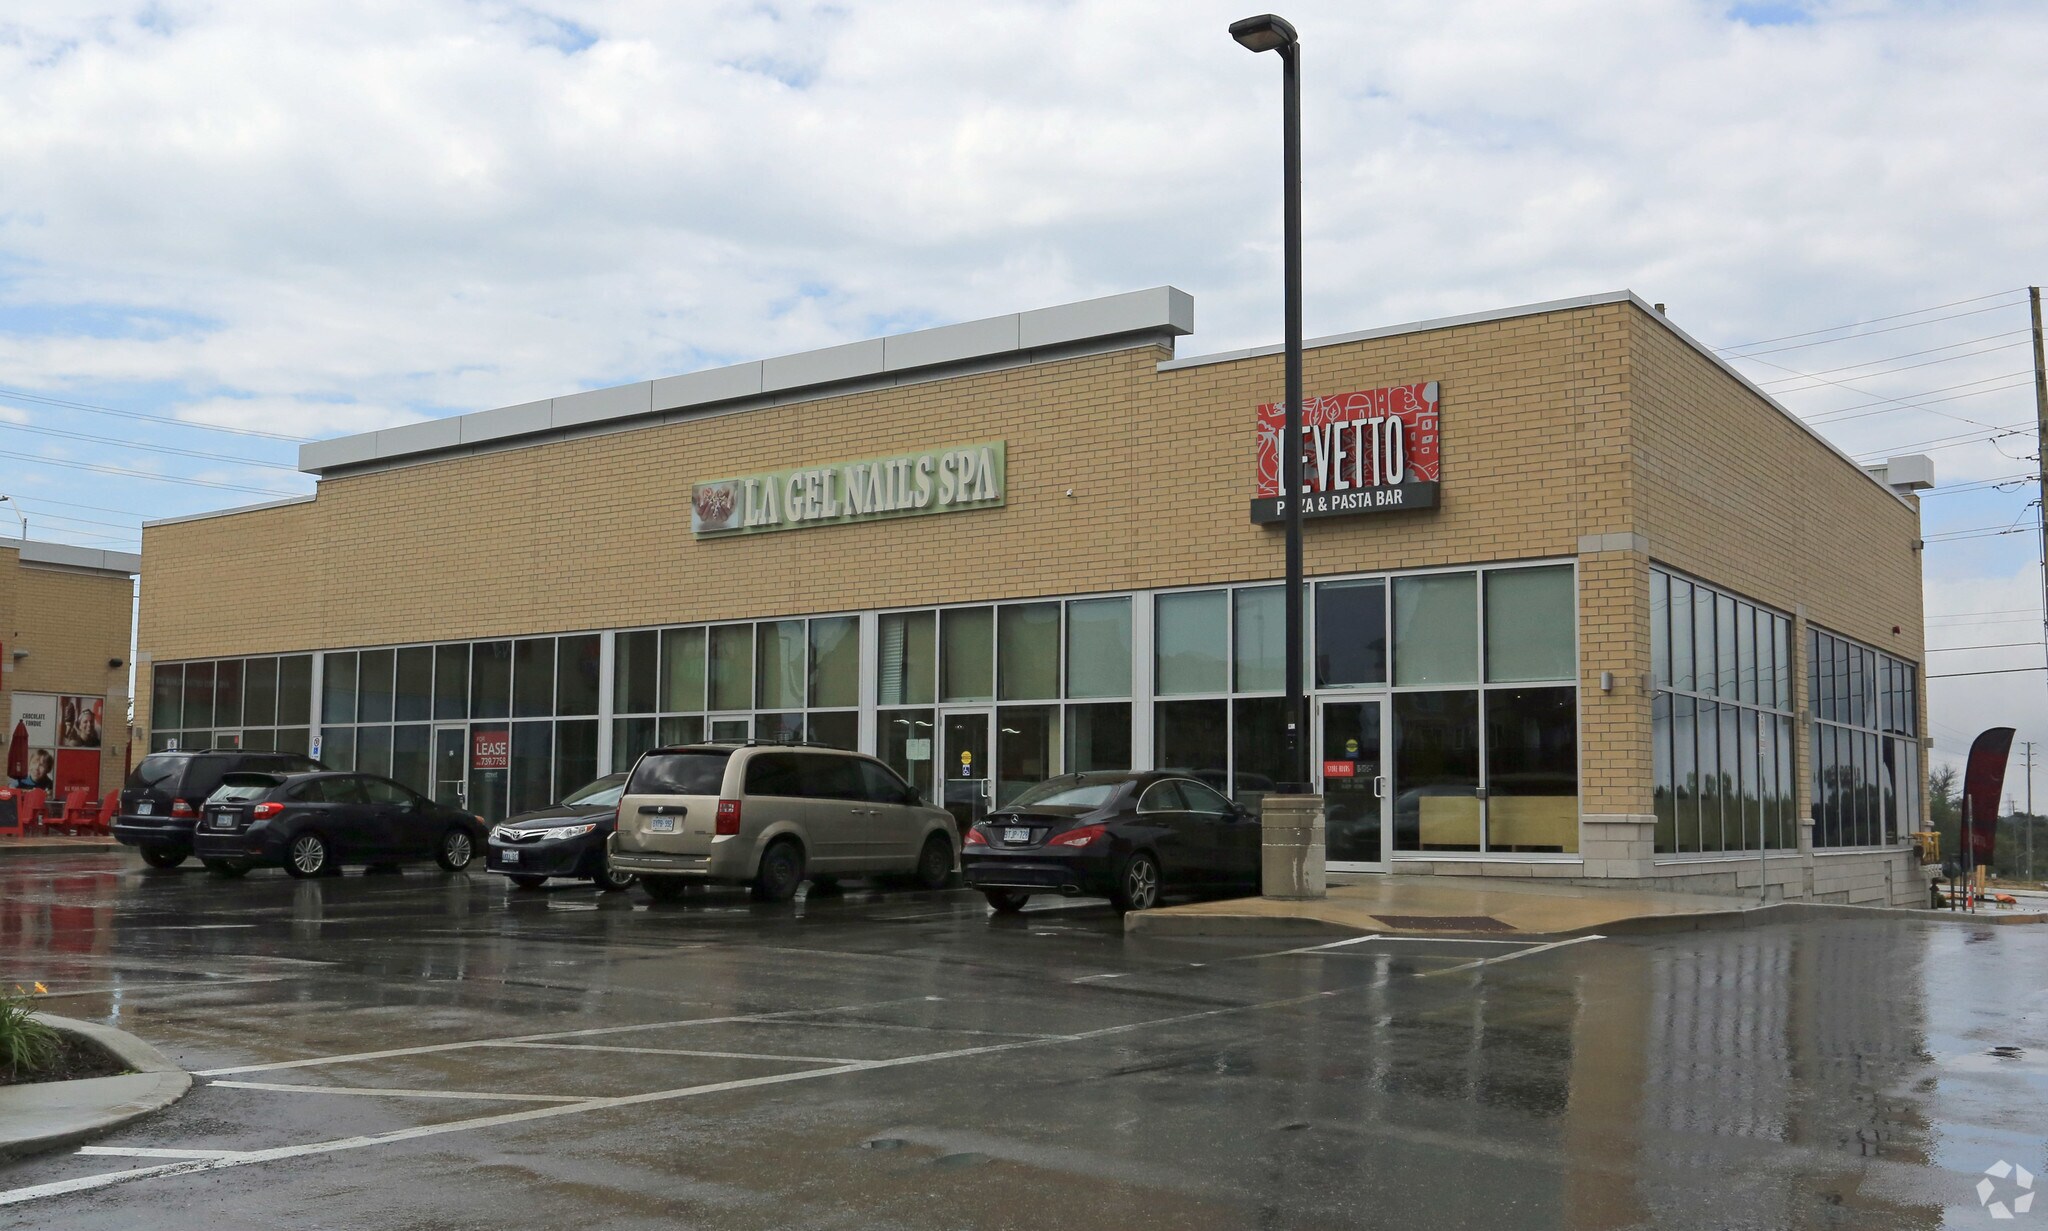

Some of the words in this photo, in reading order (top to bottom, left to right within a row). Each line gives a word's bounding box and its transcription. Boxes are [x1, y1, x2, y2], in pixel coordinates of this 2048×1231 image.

[744, 476, 782, 526] LA
[784, 468, 842, 521] GEL
[844, 455, 935, 515] NAILS
[938, 447, 999, 504] SPA
[1318, 497, 1327, 511] &
[1332, 491, 1372, 510] PASTA
[1376, 489, 1403, 506] BAR
[476, 742, 506, 755] LEASE
